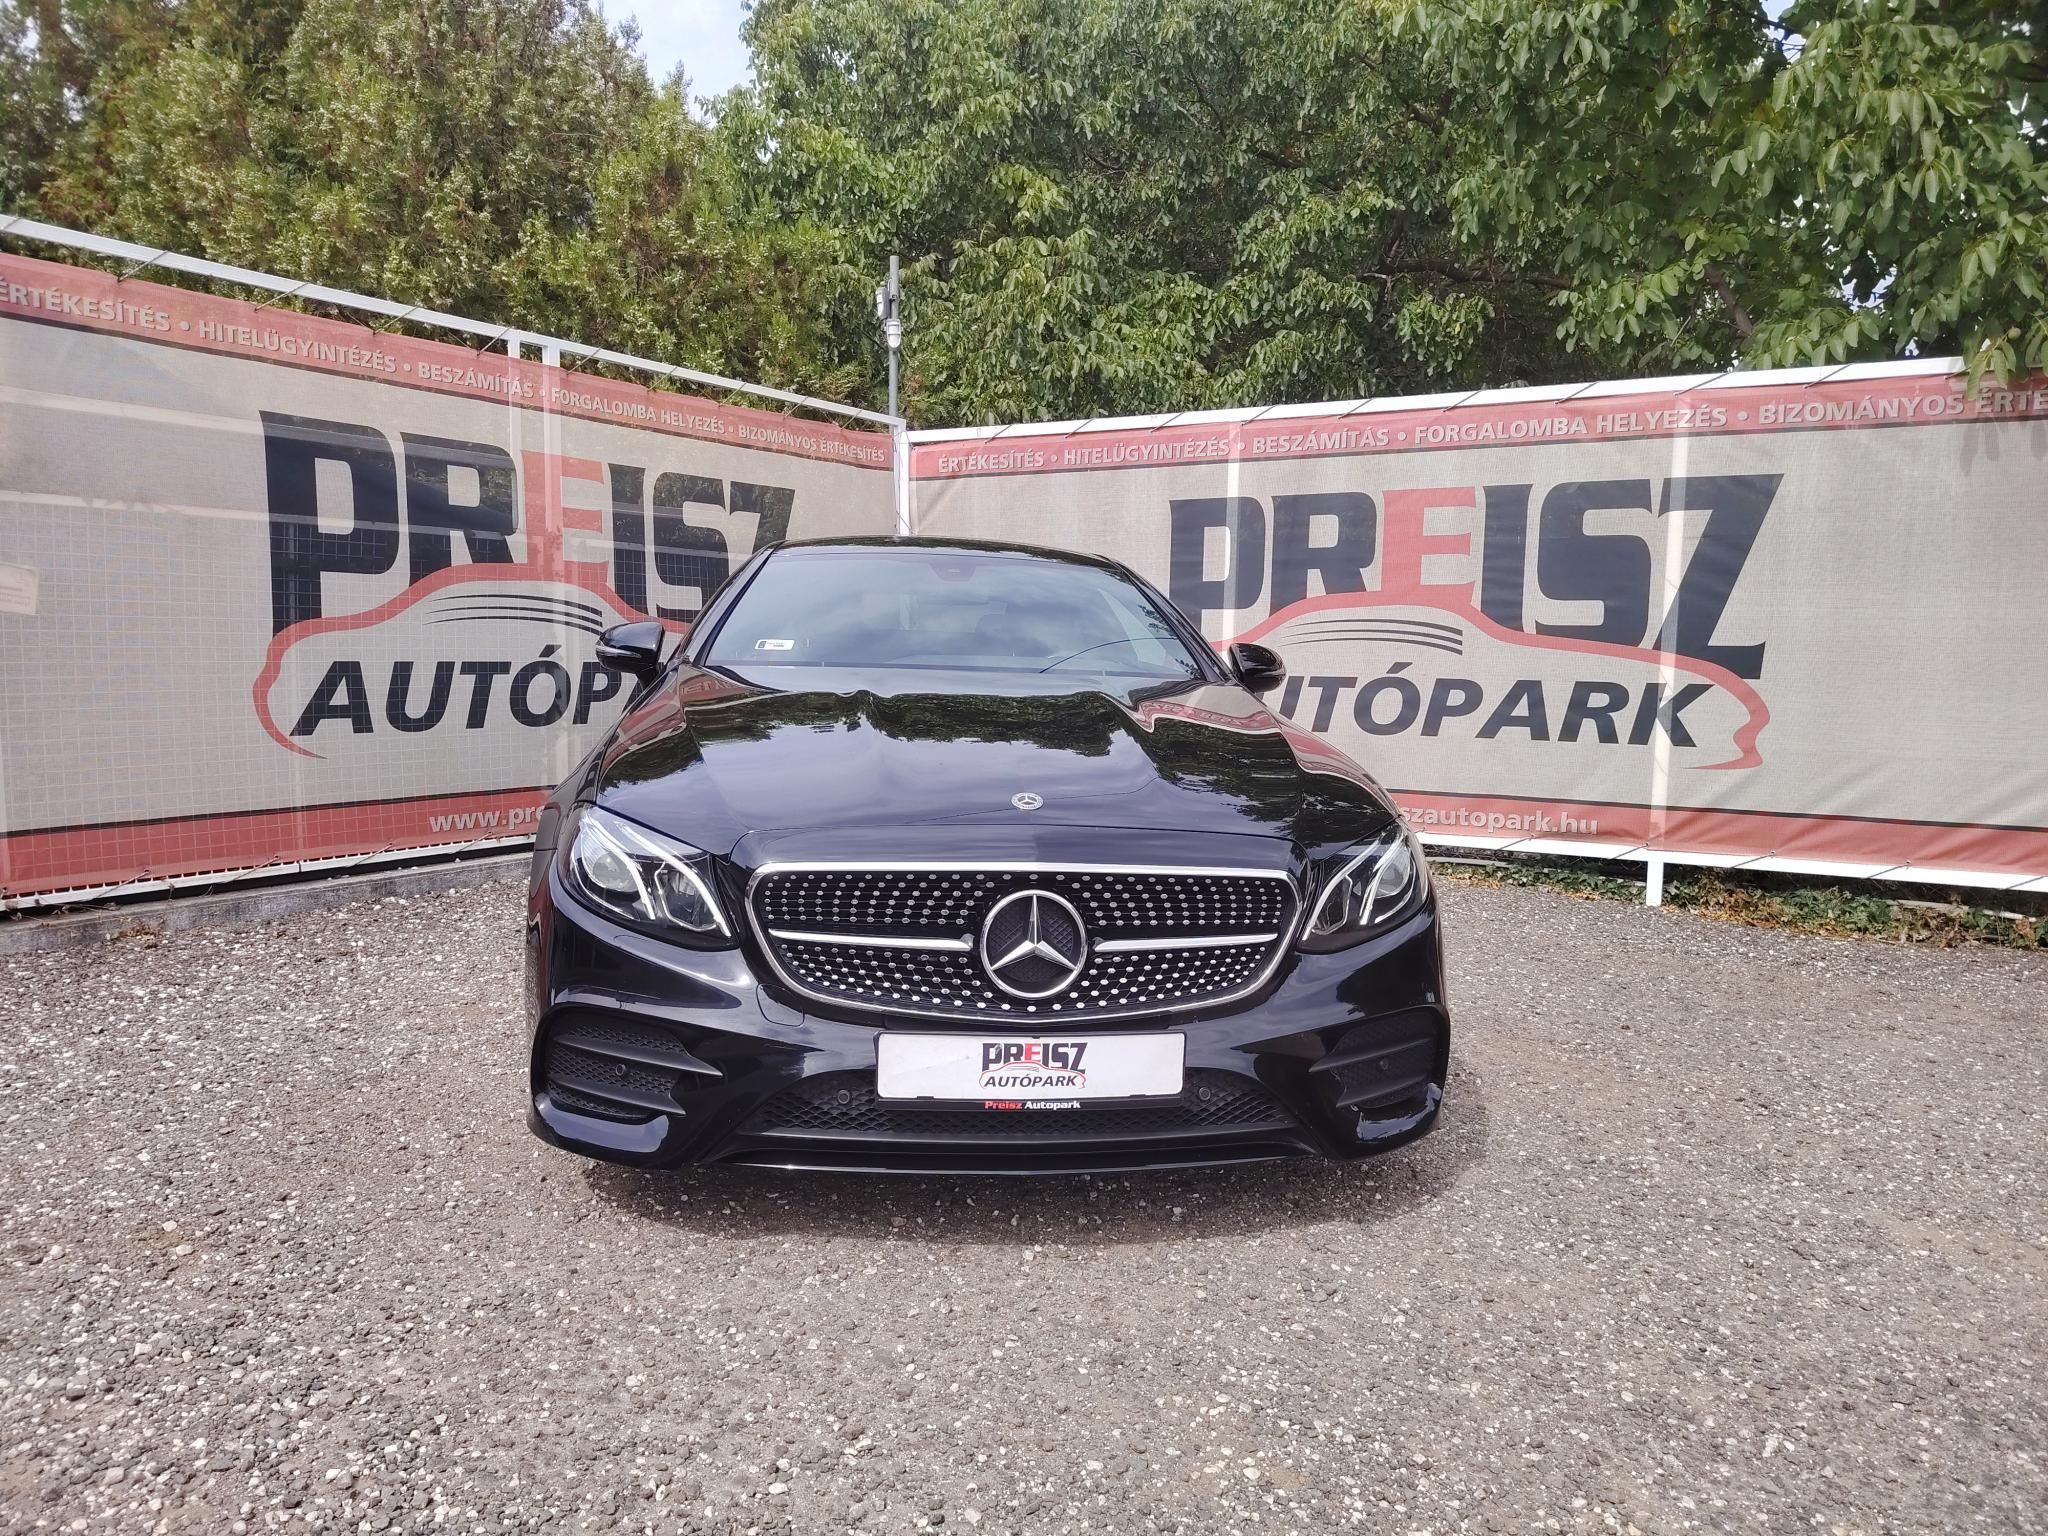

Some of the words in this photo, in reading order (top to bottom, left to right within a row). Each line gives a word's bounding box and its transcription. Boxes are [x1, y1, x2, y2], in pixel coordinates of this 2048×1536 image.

[199, 319, 397, 373] HITELÜGYINTÉZÉS
[418, 361, 534, 398] BESZÁMÍTÁS
[551, 387, 657, 421] FORGALOMBA
[661, 409, 725, 434] HELYEZÉS
[738, 424, 817, 450] BIZOMÁNYOS
[820, 435, 885, 462] ÉRTÉKESÍTÉS
[938, 448, 1044, 473] ÉRTÉKESÍTÉS
[1064, 436, 1229, 465] HITELÜGYINTÉZÉS
[1253, 426, 1390, 454] BESZÁMÍTÁS
[1415, 416, 1588, 444] FORGALOMBA
[1596, 404, 1727, 433] HELYEZÉS
[1759, 394, 1965, 424] BIZOMÁNYOS
[1169, 473, 1785, 680] PREISZ
[1400, 806, 1597, 834] szautopark.hu
[982, 1043, 1088, 1075] PREISZ
[984, 1074, 1077, 1088] AUTÓPARK
[984, 1100, 1022, 1110] Preisz
[1024, 1100, 1081, 1111] Autopark
